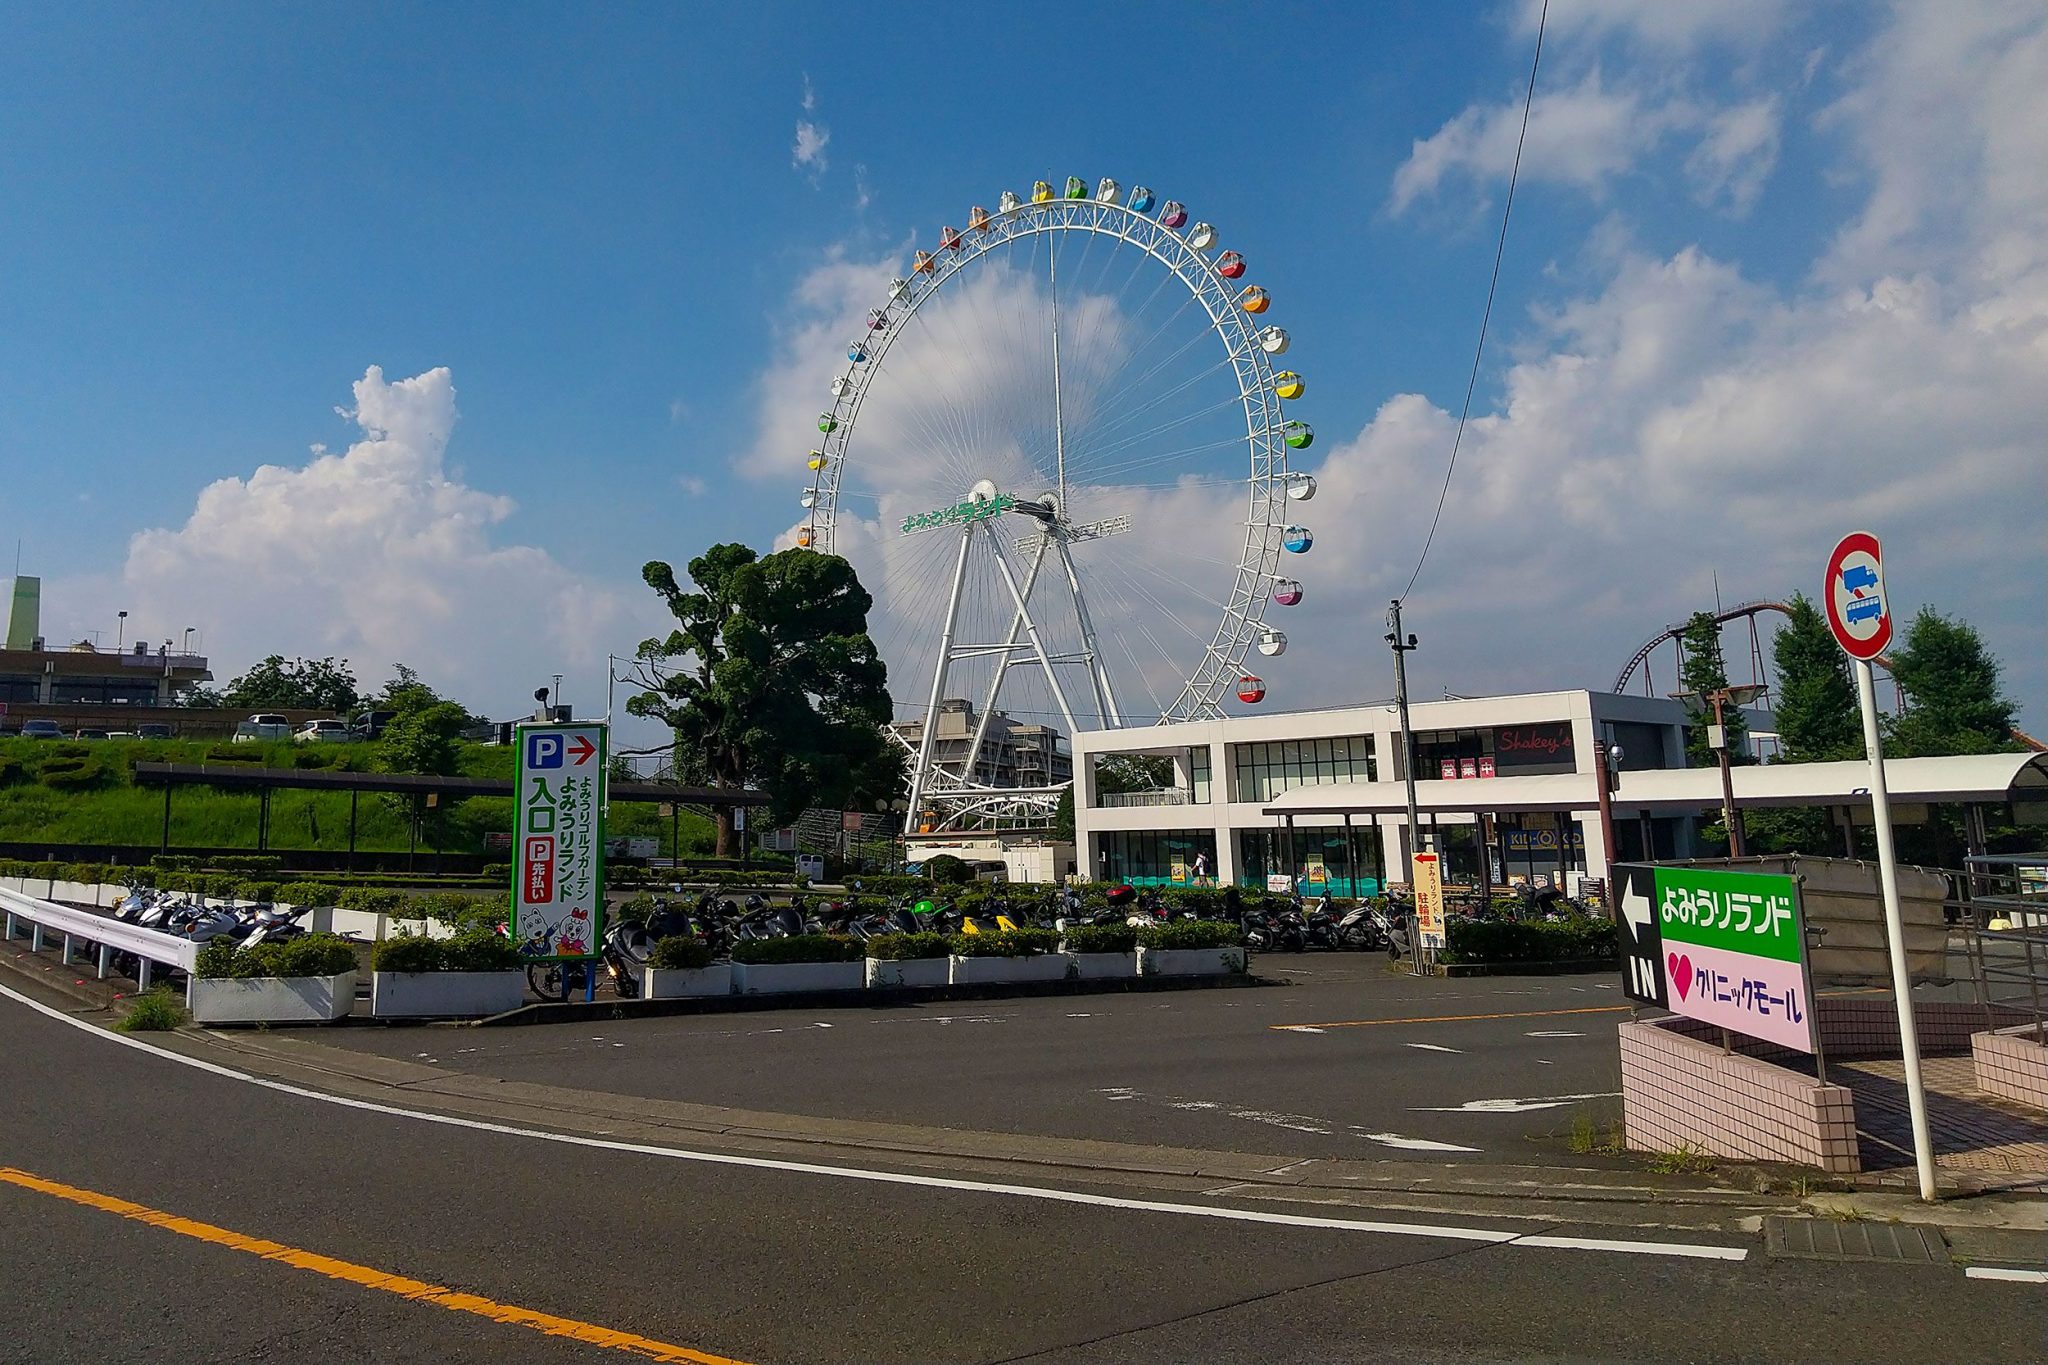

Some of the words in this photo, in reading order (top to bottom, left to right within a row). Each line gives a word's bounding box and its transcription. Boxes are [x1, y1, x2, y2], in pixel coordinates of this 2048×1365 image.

[535, 739, 557, 766] P
[1500, 728, 1572, 753] Shakey's
[527, 777, 557, 833] 入口
[534, 844, 547, 857] P
[558, 776, 577, 902] よみうりランド
[576, 776, 592, 900] よみうりゴルフガーデン
[531, 861, 546, 899] 先払い
[1428, 862, 1439, 914] よみうりランド
[1417, 892, 1431, 928] 駐輪場
[1661, 886, 1791, 937] よみうりランド
[1629, 955, 1657, 1000] IN
[1695, 967, 1803, 1024] クリニックモール
